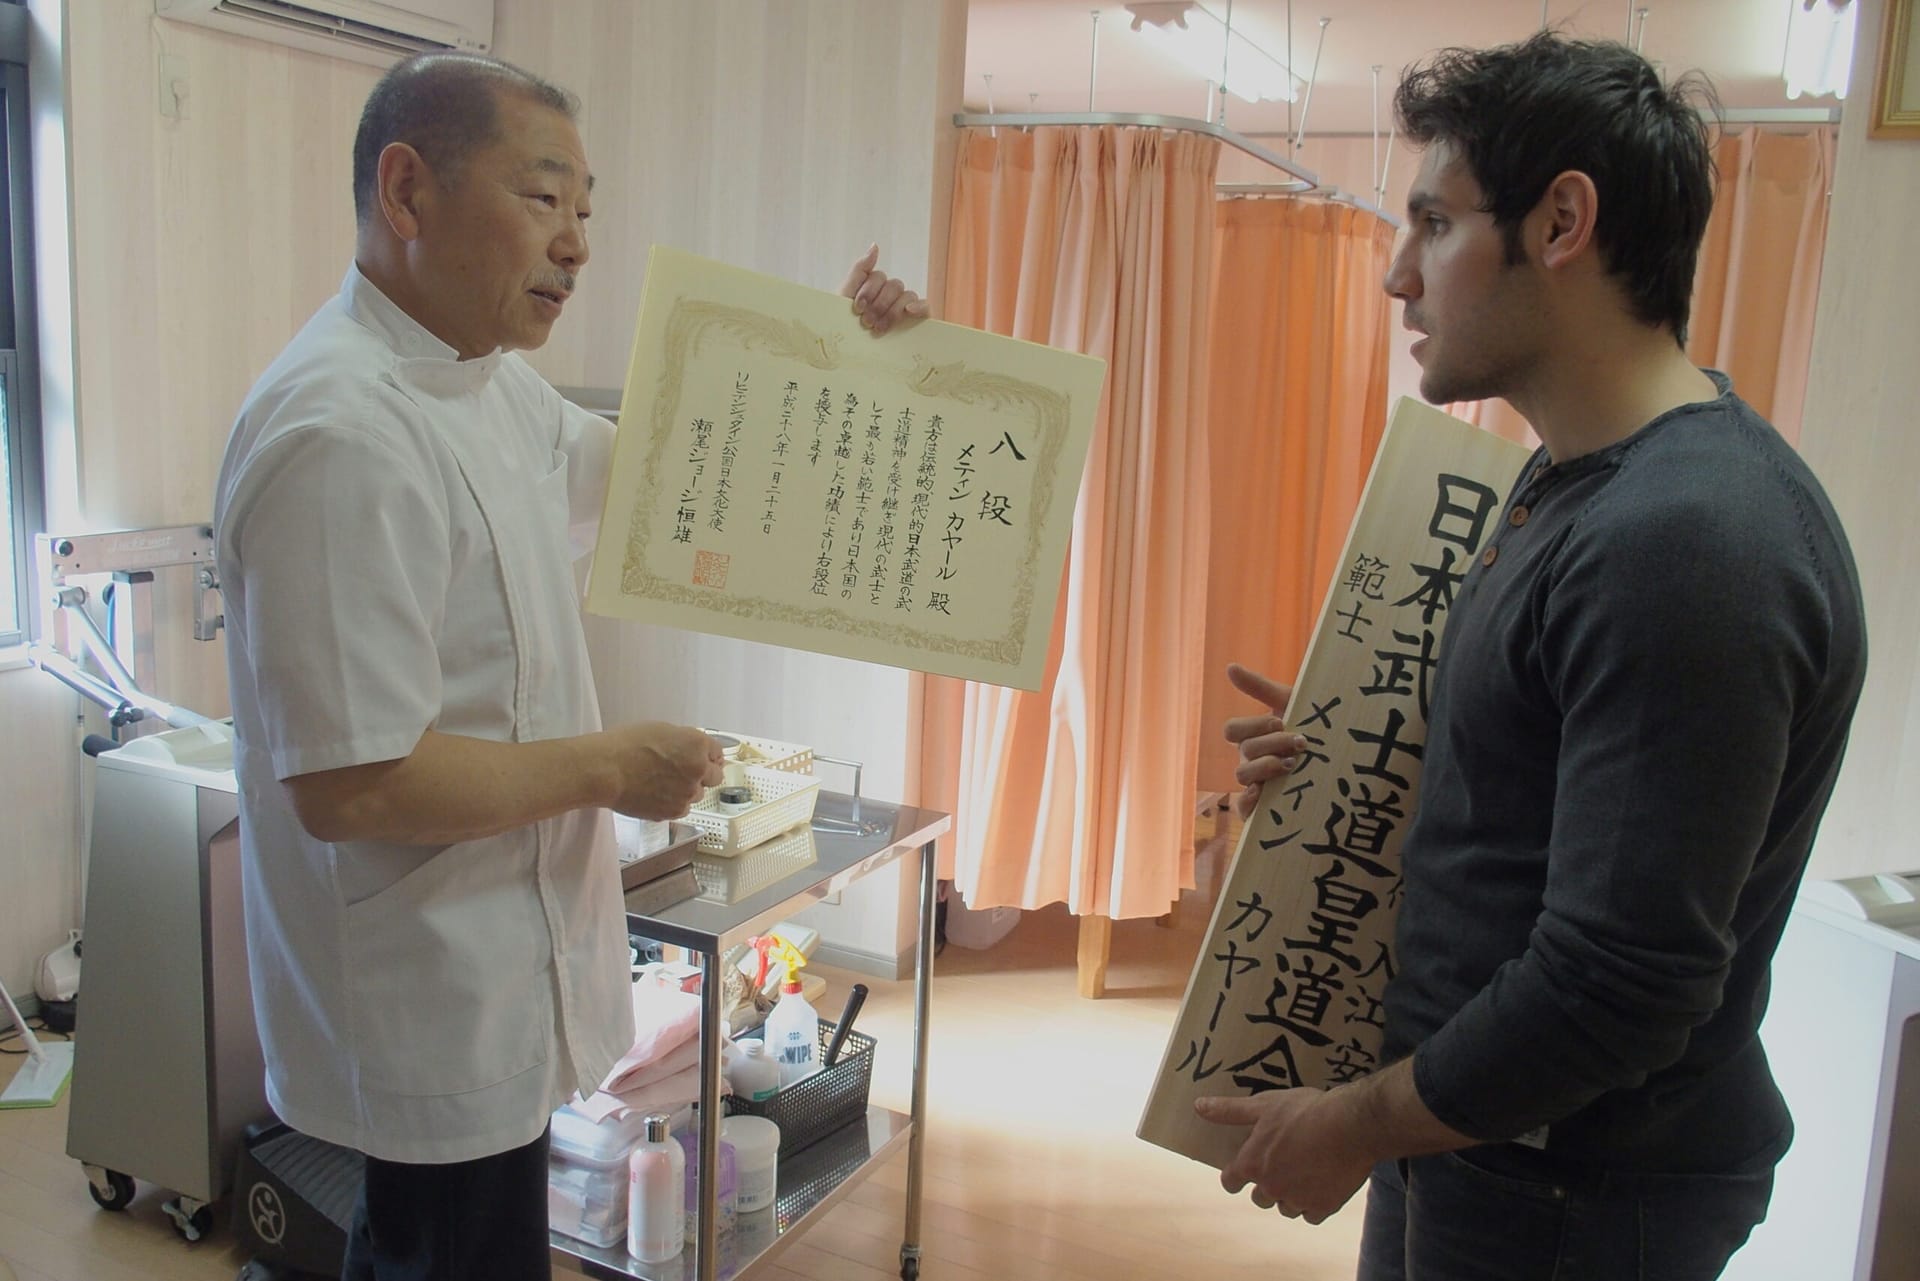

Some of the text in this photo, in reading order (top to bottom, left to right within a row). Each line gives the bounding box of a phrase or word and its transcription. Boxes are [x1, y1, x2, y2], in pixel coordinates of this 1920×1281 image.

[807, 386, 832, 467] を授与します
[977, 431, 1027, 527] 八段
[926, 443, 976, 616] メティン カヤール 殿
[1336, 552, 1390, 643] 範士
[1174, 892, 1274, 1083] カヤール
[1325, 939, 1398, 1091] 入江安
